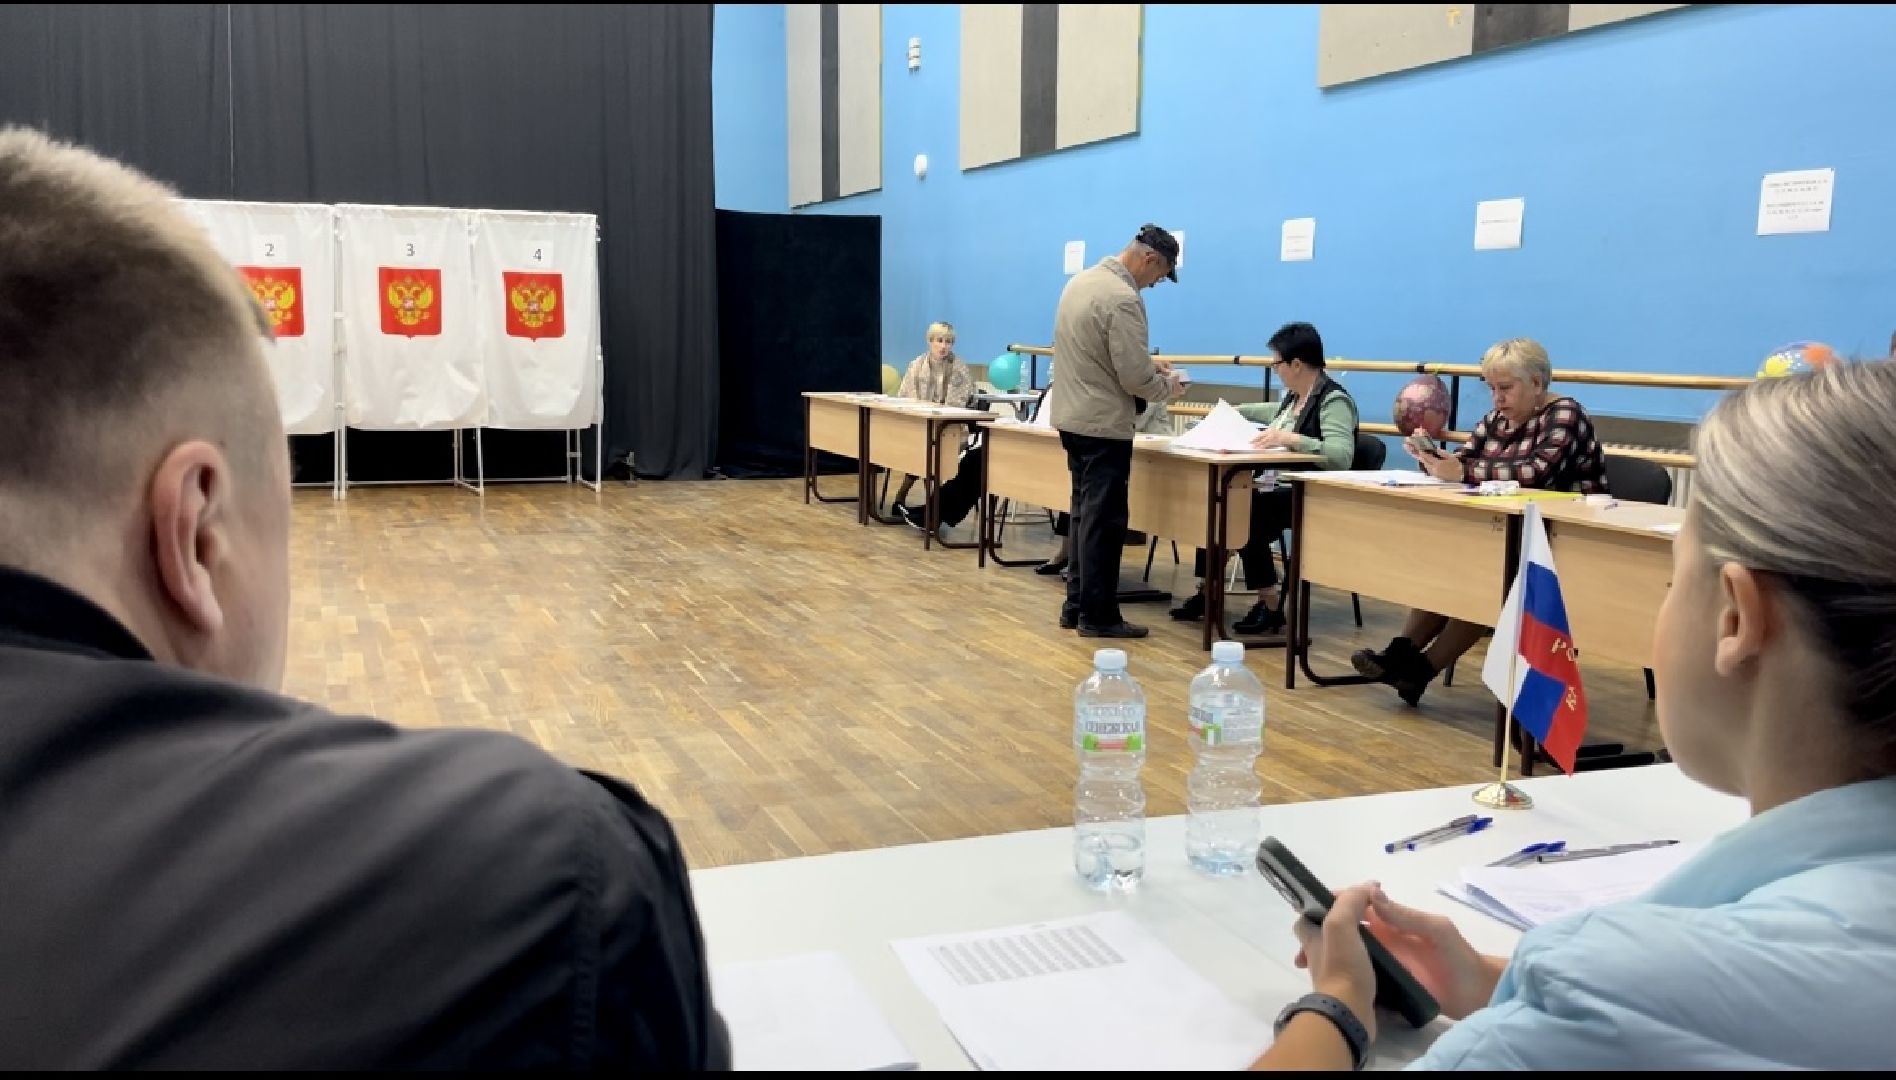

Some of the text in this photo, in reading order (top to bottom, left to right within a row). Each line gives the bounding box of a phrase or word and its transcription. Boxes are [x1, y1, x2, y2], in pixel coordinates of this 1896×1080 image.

[264, 243, 275, 257] 2
[406, 243, 416, 257] 3
[532, 248, 542, 262] 4
